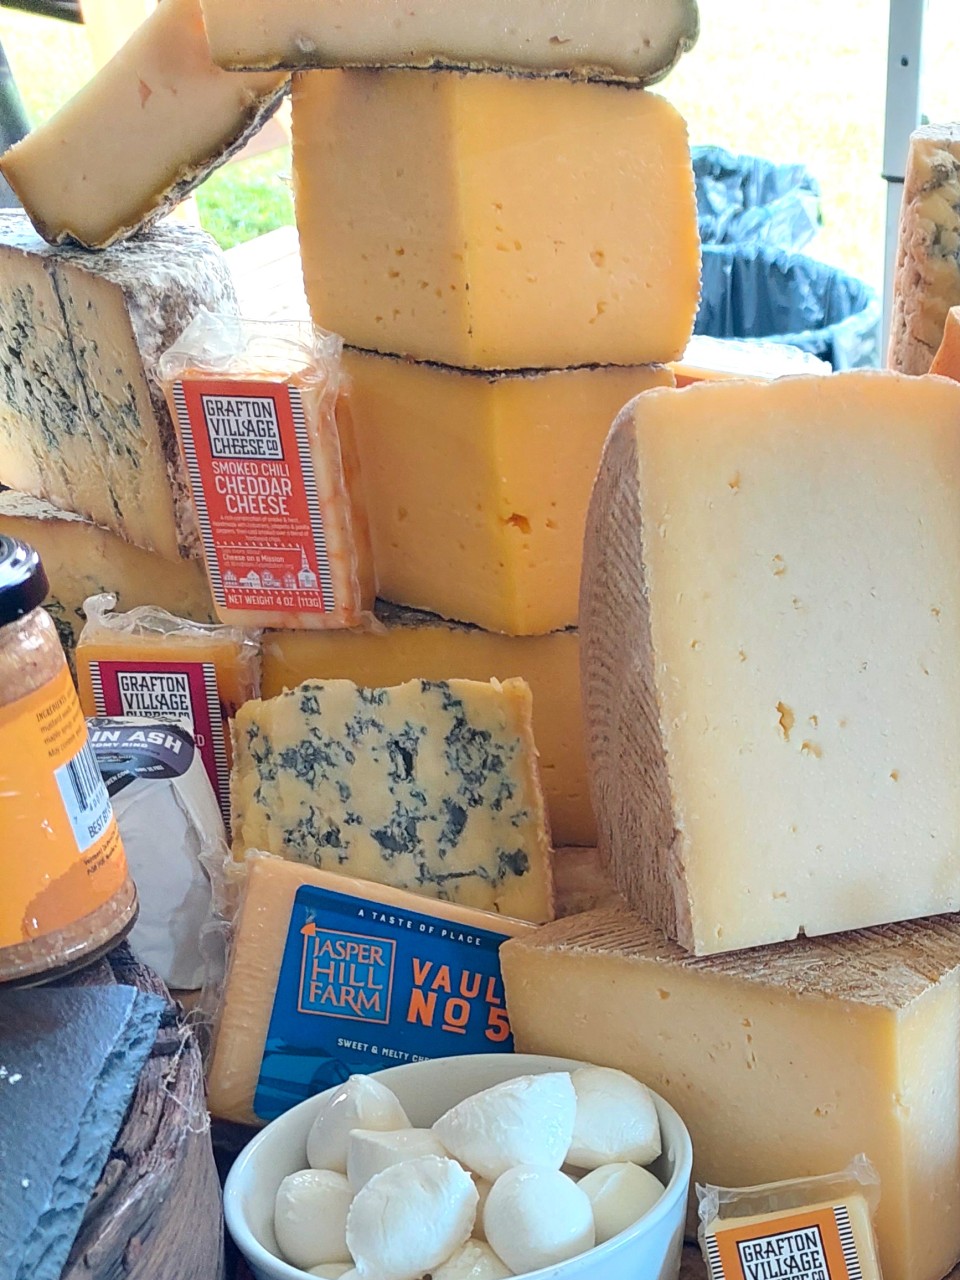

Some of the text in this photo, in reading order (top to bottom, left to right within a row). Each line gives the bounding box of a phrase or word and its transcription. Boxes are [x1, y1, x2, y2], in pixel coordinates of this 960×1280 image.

[205, 399, 272, 418] GRAFTON
[209, 418, 276, 438] VILLAGE
[212, 438, 279, 456] CHEESE CO
[211, 461, 290, 477] SMOKED CHILI
[214, 477, 292, 496] CHEDDAR
[225, 496, 289, 515] CHEESE
[228, 594, 243, 604] NET
[244, 594, 274, 606] WEIGHT
[276, 597, 282, 606] 4
[298, 596, 321, 609] (113G)
[121, 676, 186, 692] GRAFTON
[123, 694, 189, 711] VILLAGE
[91, 731, 182, 754] IN ASH
[358, 909, 481, 945] A TASTE OF PLACE
[313, 937, 385, 966] JASPER
[311, 958, 383, 989] HILL
[309, 981, 381, 1017] FARM
[485, 1007, 510, 1042] 5
[337, 1038, 409, 1061] SWEET & MELTY
[741, 1230, 818, 1264] GRAFTON
